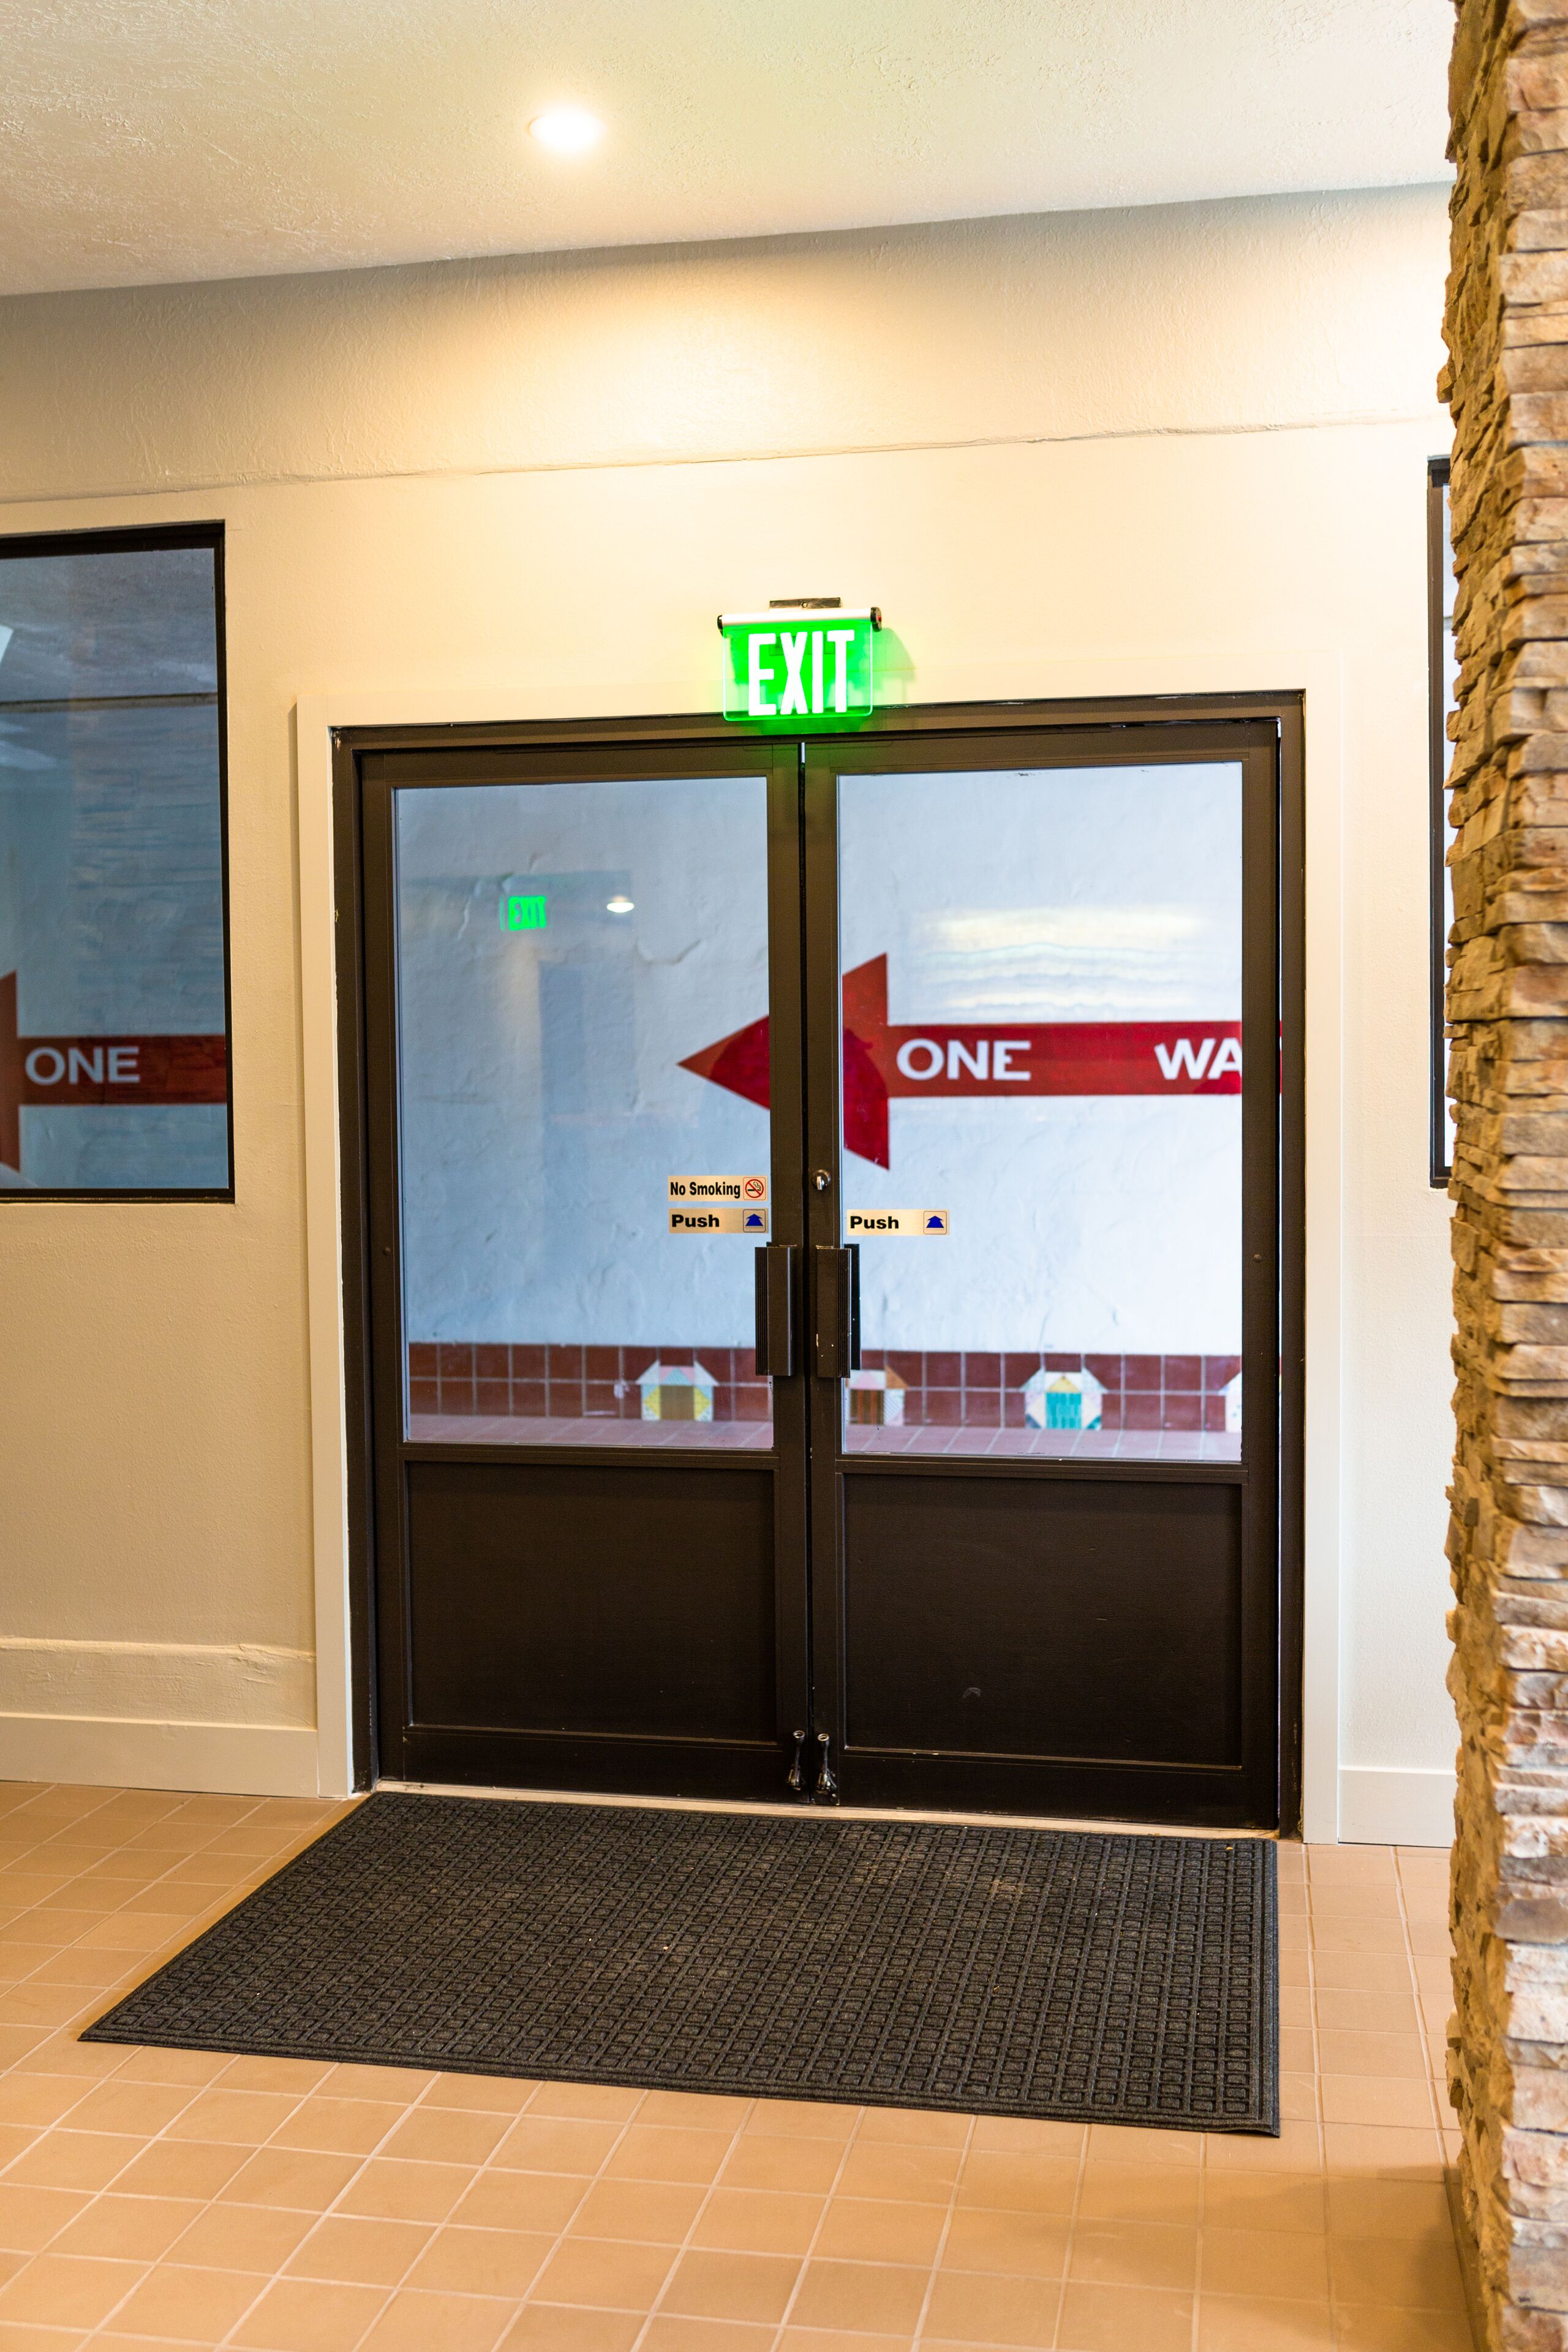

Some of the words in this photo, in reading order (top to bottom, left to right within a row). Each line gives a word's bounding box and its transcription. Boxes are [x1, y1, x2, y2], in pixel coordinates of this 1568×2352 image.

[748, 629, 855, 716] EXIT
[25, 1046, 141, 1086] ONE
[896, 1038, 1031, 1081] ONE
[1153, 1038, 1242, 1080] WA
[670, 1182, 685, 1196] No
[689, 1182, 741, 1199] Smoking
[671, 1214, 720, 1227] Push
[850, 1215, 899, 1229] Push
